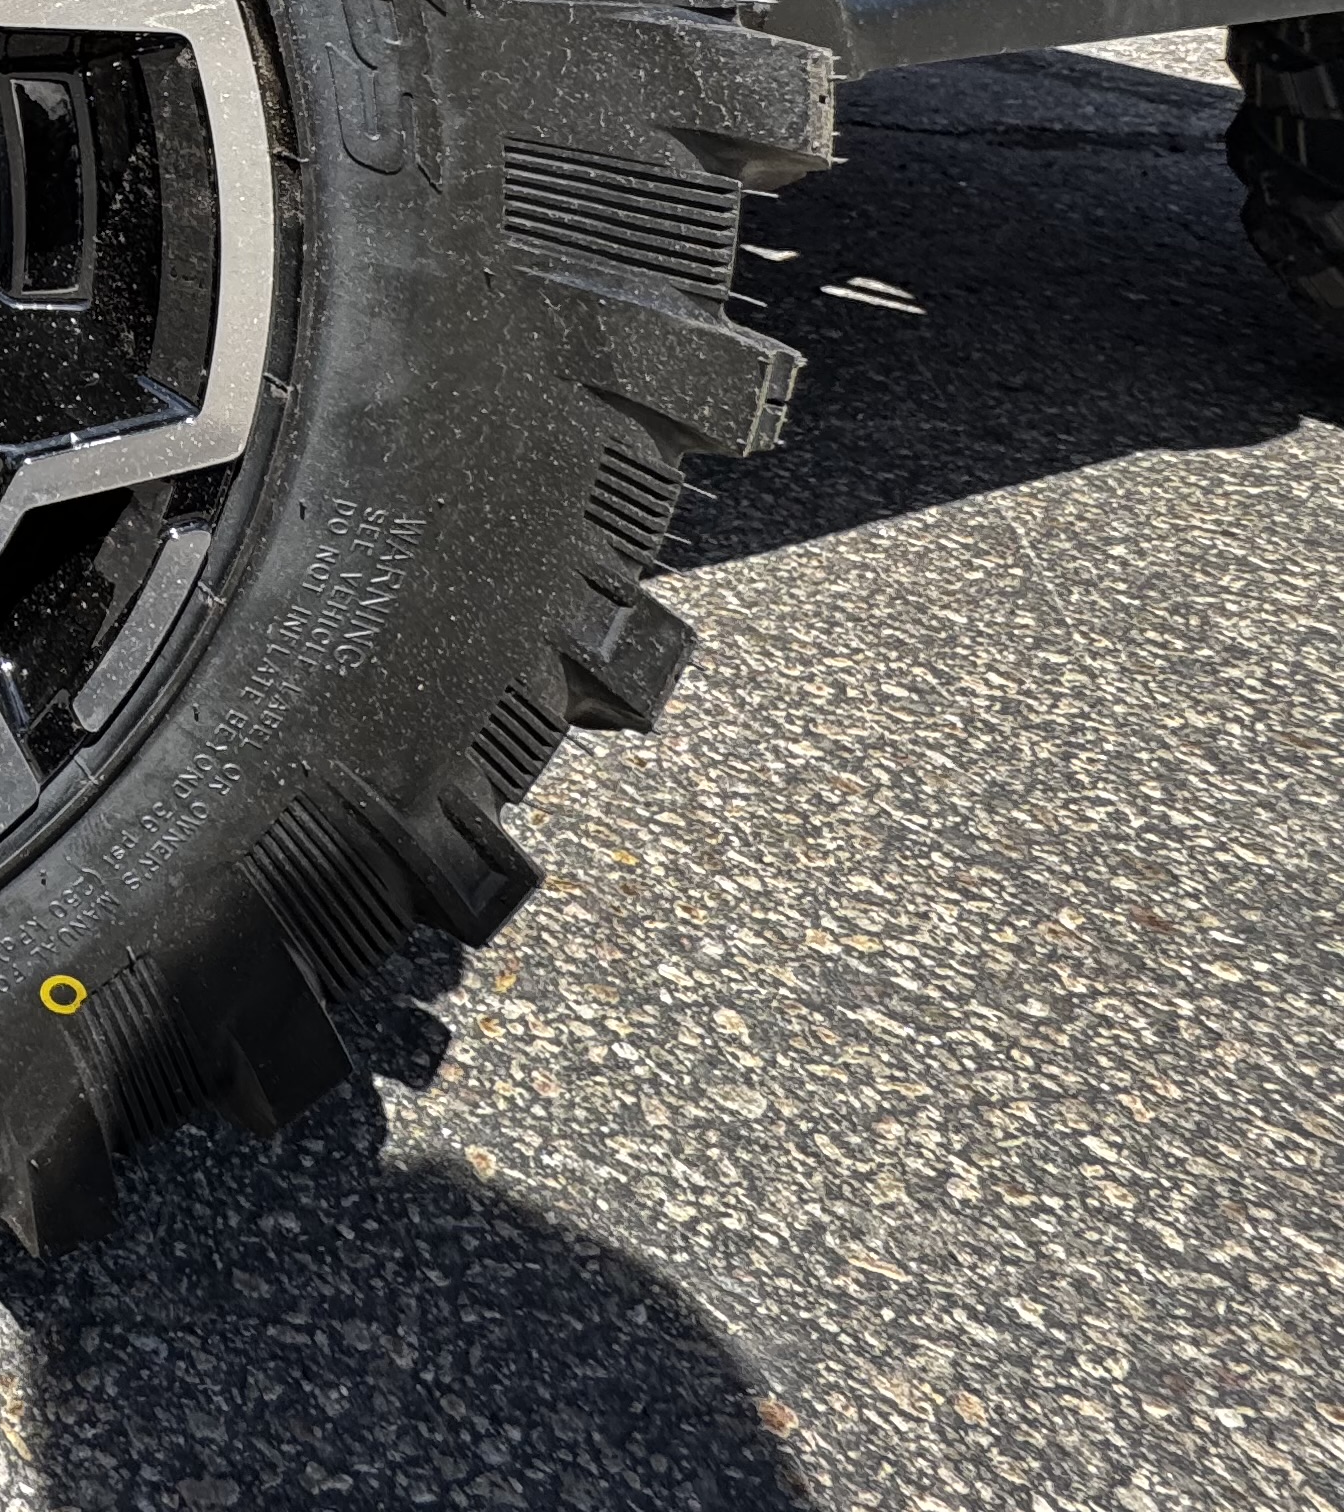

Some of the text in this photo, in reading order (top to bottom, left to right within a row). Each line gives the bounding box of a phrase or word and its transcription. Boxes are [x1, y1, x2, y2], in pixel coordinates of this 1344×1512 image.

[327, 498, 359, 536] DO
[349, 506, 388, 556] SEE
[301, 544, 340, 593] NOT
[239, 604, 313, 705] INFLATE
[297, 573, 363, 671] VEHICLE
[238, 681, 304, 750] LABEL
[172, 709, 250, 800] BEYOND
[208, 762, 242, 796] OR
[121, 800, 210, 890] OWNER'S
